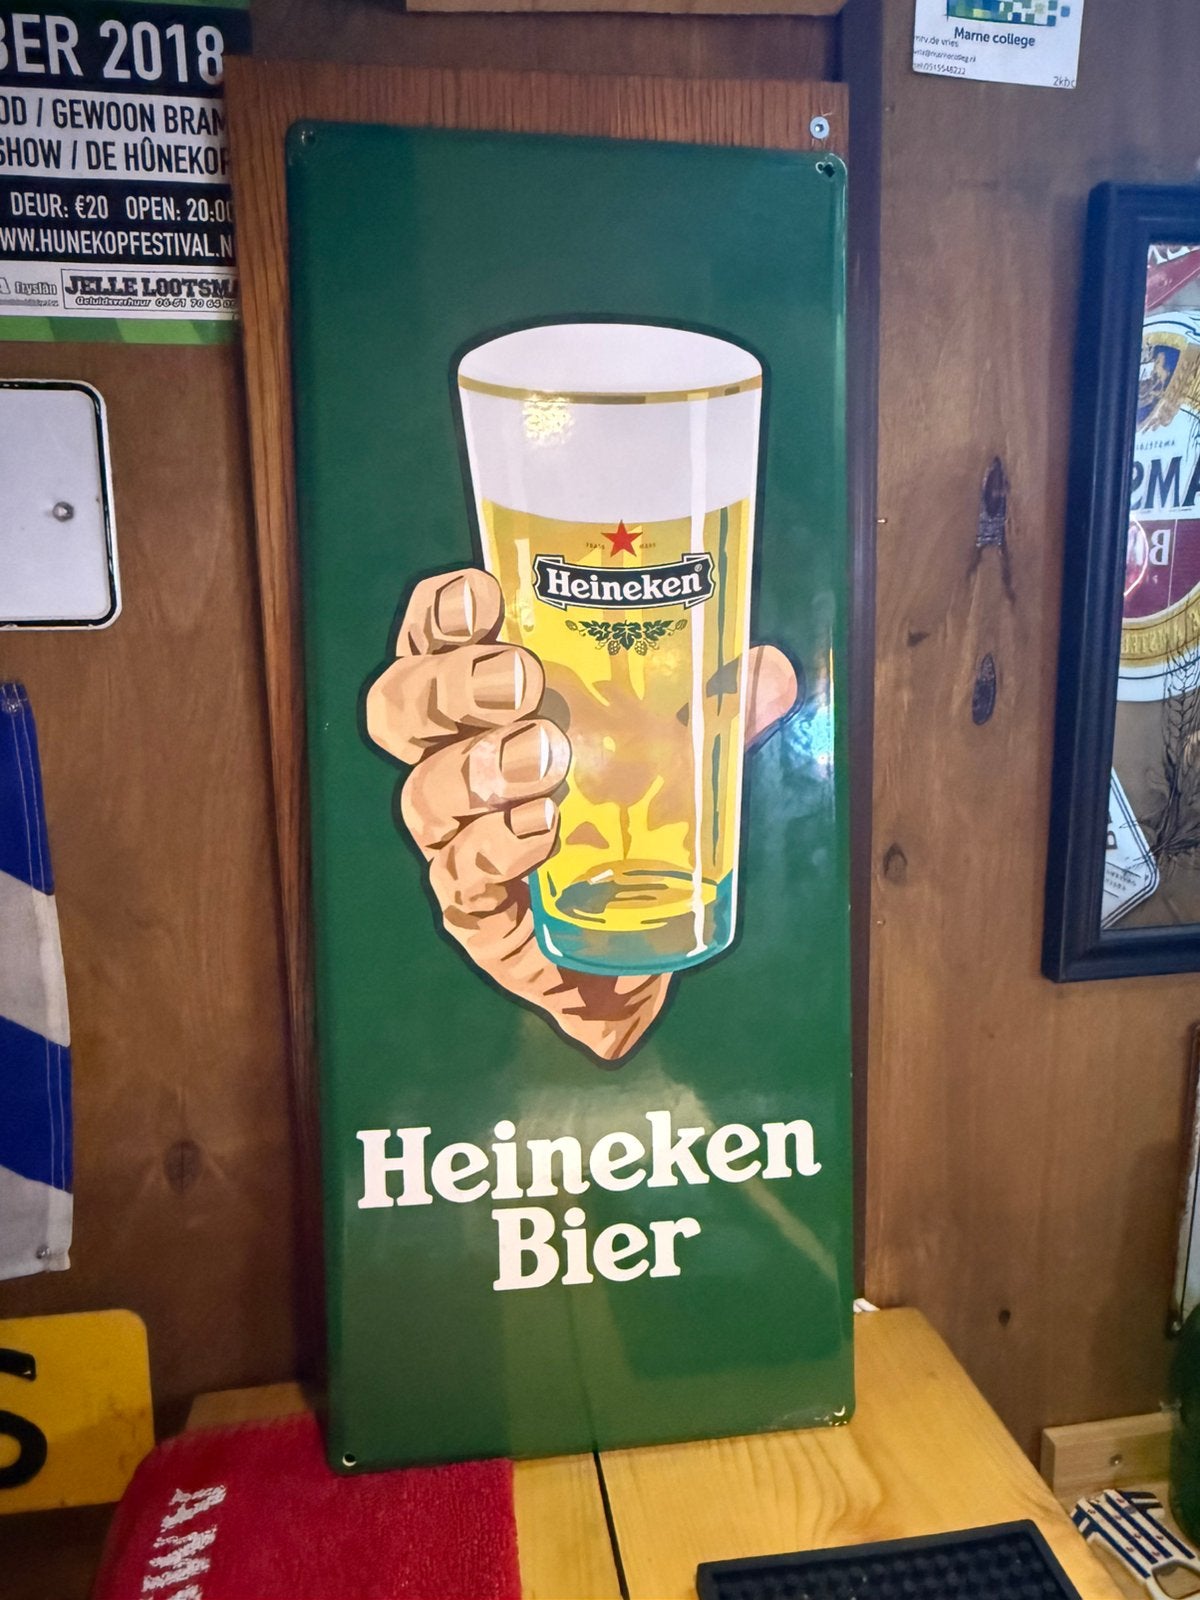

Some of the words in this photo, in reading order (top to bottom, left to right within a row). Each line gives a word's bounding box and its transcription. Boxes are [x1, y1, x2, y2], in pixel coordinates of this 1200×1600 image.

[100, 19, 224, 85] 2018
[954, 26, 990, 43] Marne
[992, 33, 1036, 49] college
[52, 98, 155, 133] GEWOON
[86, 140, 116, 171] DE
[10, 191, 69, 218] DEUR:
[75, 195, 109, 219] €20
[126, 196, 181, 221] OPEN:
[65, 276, 137, 296] JELLE
[546, 567, 702, 601] Heineken
[356, 1110, 822, 1209] Heineken
[491, 1206, 702, 1291] Bier
